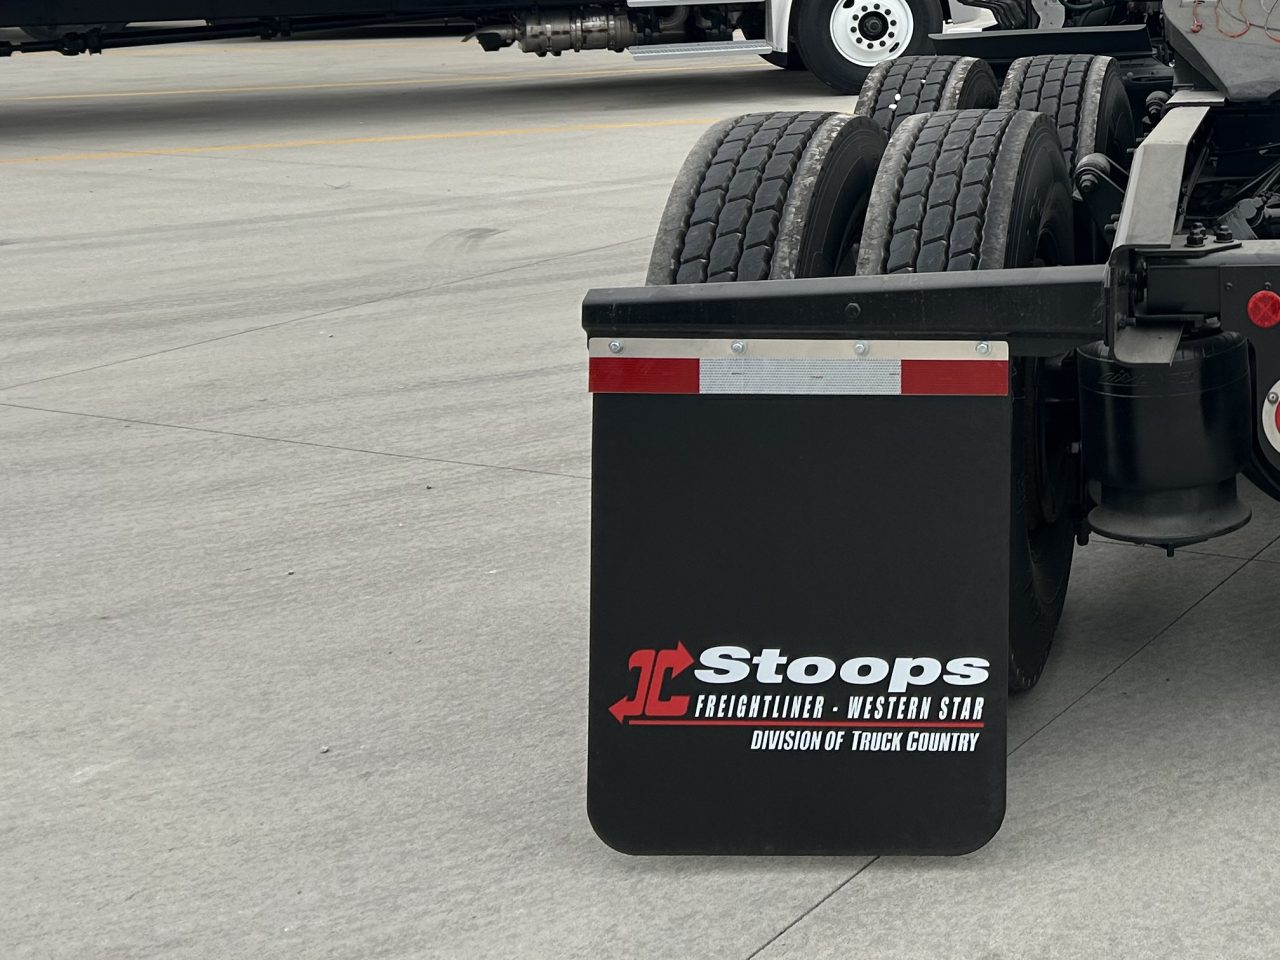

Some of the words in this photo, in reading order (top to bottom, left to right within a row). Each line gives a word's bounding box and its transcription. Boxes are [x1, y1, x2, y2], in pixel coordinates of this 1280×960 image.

[694, 646, 991, 693] Stoops
[694, 695, 824, 718] FREIGHTLINER
[847, 696, 930, 720] WESTERN
[938, 697, 985, 720] STAR
[750, 730, 821, 751] DIVISION
[824, 730, 845, 751] OF
[851, 731, 902, 752] TRUCK
[905, 731, 980, 752] COUNTRY
